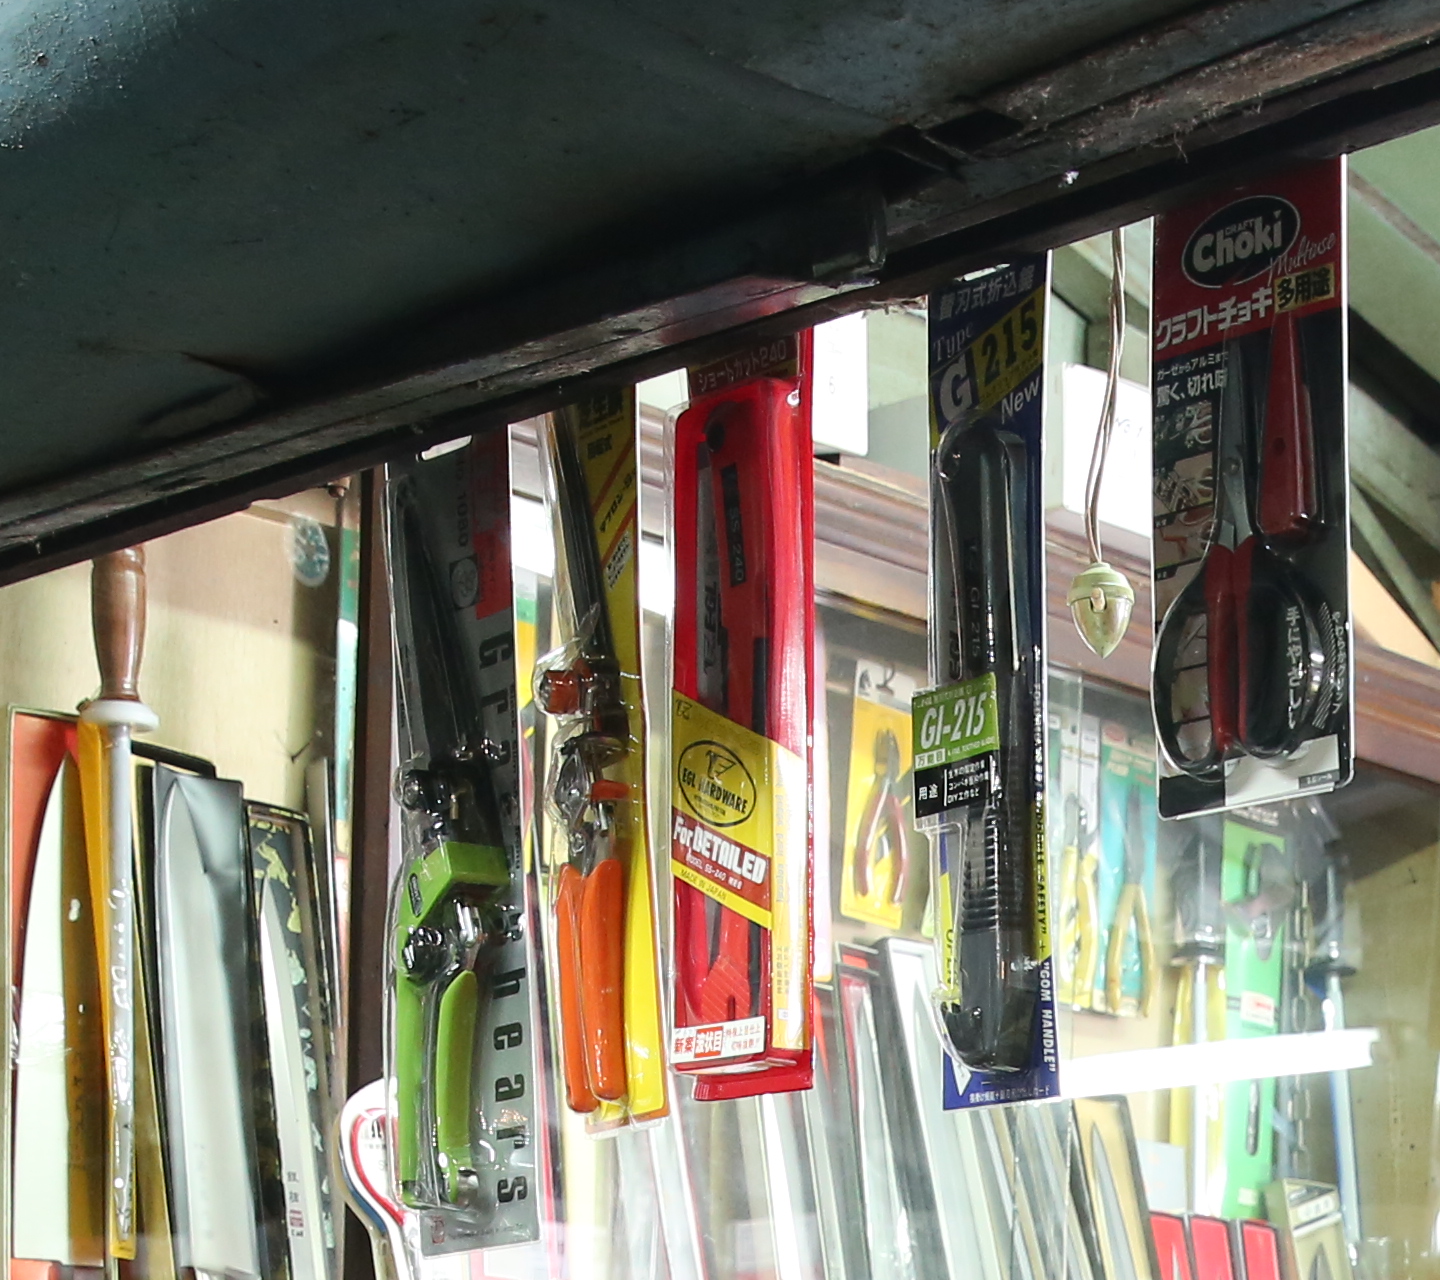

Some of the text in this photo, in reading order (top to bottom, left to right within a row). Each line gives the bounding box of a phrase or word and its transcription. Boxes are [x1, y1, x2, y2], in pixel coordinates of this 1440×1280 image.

[1192, 208, 1283, 274] Choki
[1276, 266, 1332, 310] 多用途
[933, 322, 975, 362] Type
[981, 296, 1039, 387] 215
[1155, 286, 1274, 351] クラフトチョキ
[1000, 375, 1041, 424] New
[920, 691, 988, 750] GI-215
[680, 766, 749, 815] EGL HARDWARE
[917, 783, 939, 801] 用途
[672, 815, 768, 885] For DETAILED
[679, 868, 699, 888] MADE
[705, 881, 729, 902] JAPAN
